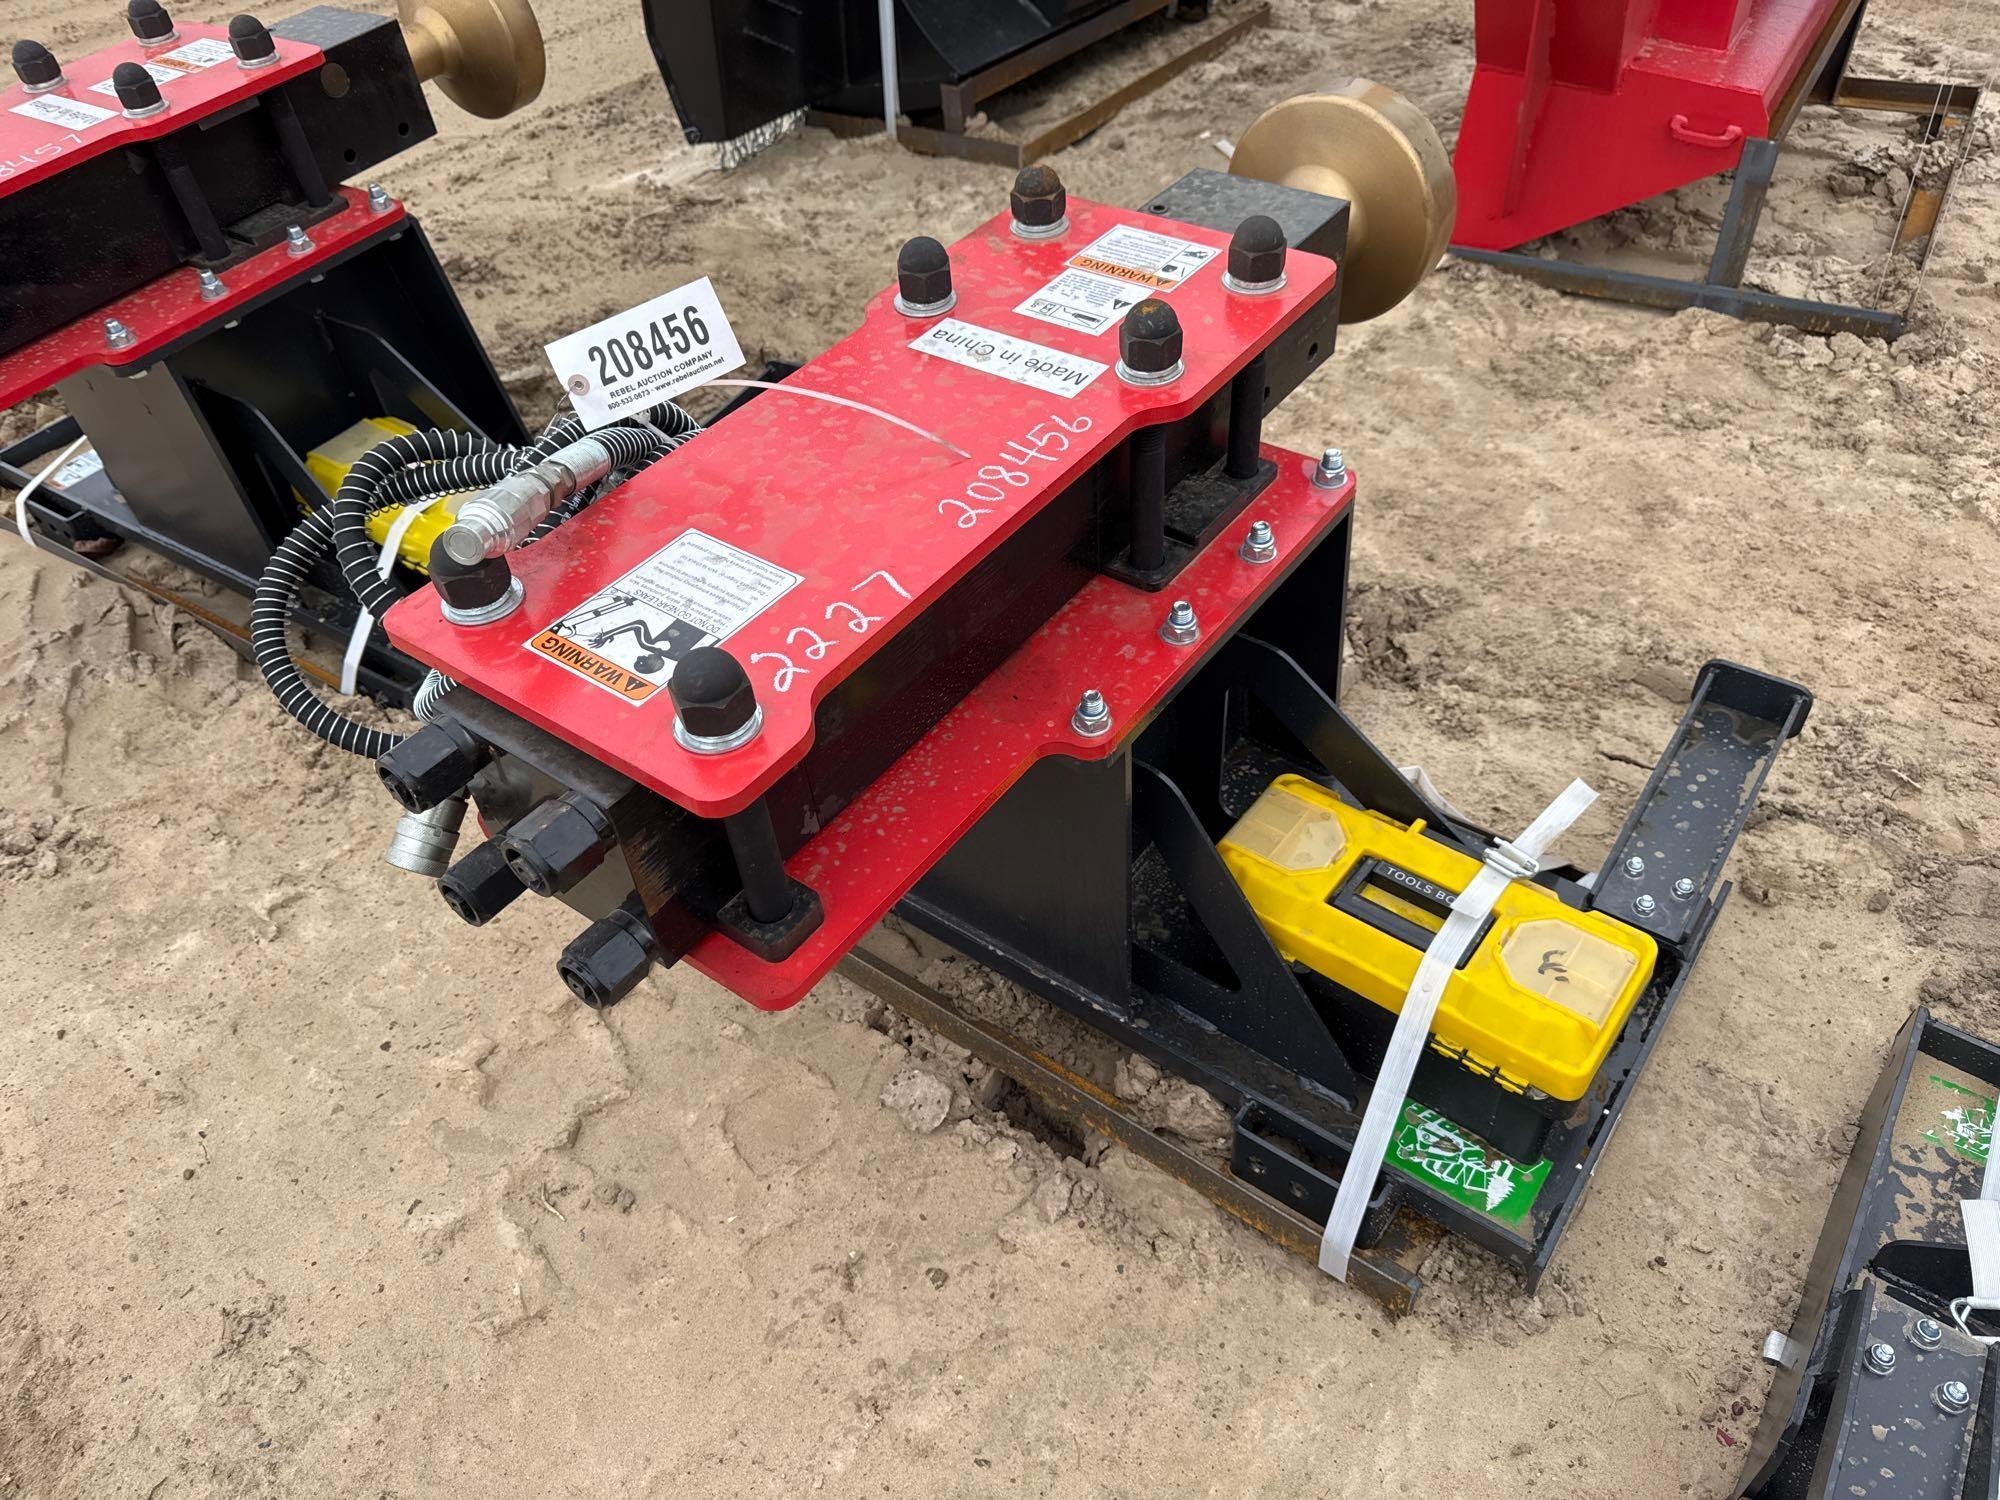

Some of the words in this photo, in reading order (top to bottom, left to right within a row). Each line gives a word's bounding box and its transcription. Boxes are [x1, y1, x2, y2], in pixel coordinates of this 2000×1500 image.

[1080, 259, 1153, 284] WARNING
[588, 305, 710, 387] 208456
[932, 329, 996, 356] China
[998, 350, 1022, 369] in
[1024, 356, 1090, 386] Made
[607, 389, 650, 411] 800-533-0673
[654, 356, 725, 392] www.rebelauction.net
[609, 384, 636, 399] REBEL
[637, 368, 673, 389] AUCTION
[673, 350, 713, 373] COMPANY
[938, 414, 1093, 529] 208456
[633, 589, 660, 604] LEAKS
[658, 600, 680, 615] NEAR
[677, 610, 692, 619] GO
[690, 617, 708, 627] NOT
[705, 624, 720, 633] DO
[750, 570, 911, 693] 2227
[540, 635, 623, 685] WARNING
[1386, 866, 1432, 894] TOOLS
[1435, 890, 1459, 904] BO
